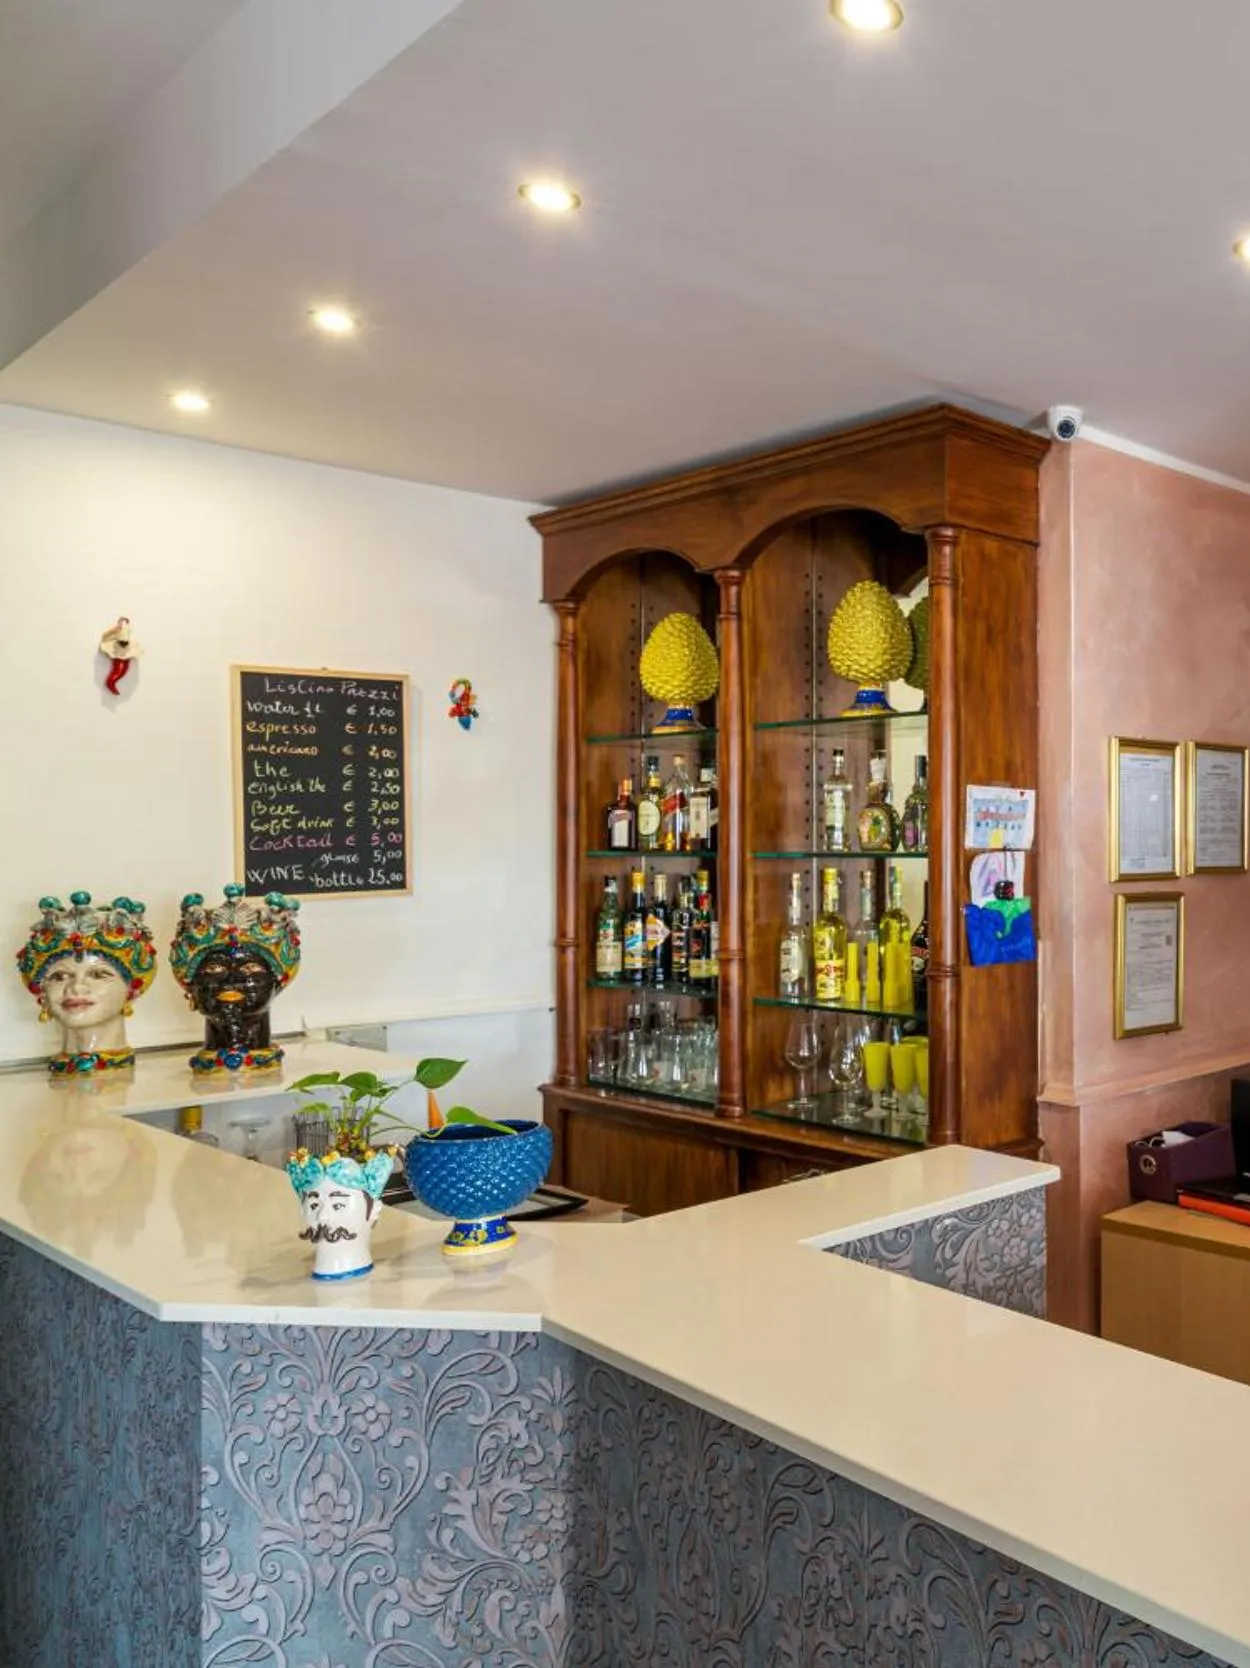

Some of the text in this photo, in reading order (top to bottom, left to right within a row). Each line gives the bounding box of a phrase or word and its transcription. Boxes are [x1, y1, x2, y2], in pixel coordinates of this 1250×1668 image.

[347, 705, 357, 715] €
[246, 722, 316, 741] espresso
[344, 722, 357, 734] €
[254, 760, 292, 777] the
[343, 764, 355, 775] €
[343, 780, 354, 791] €
[251, 802, 300, 815] Beer
[344, 802, 355, 812] €
[346, 817, 355, 828] €
[346, 834, 356, 846] €
[248, 864, 304, 884] WINE
